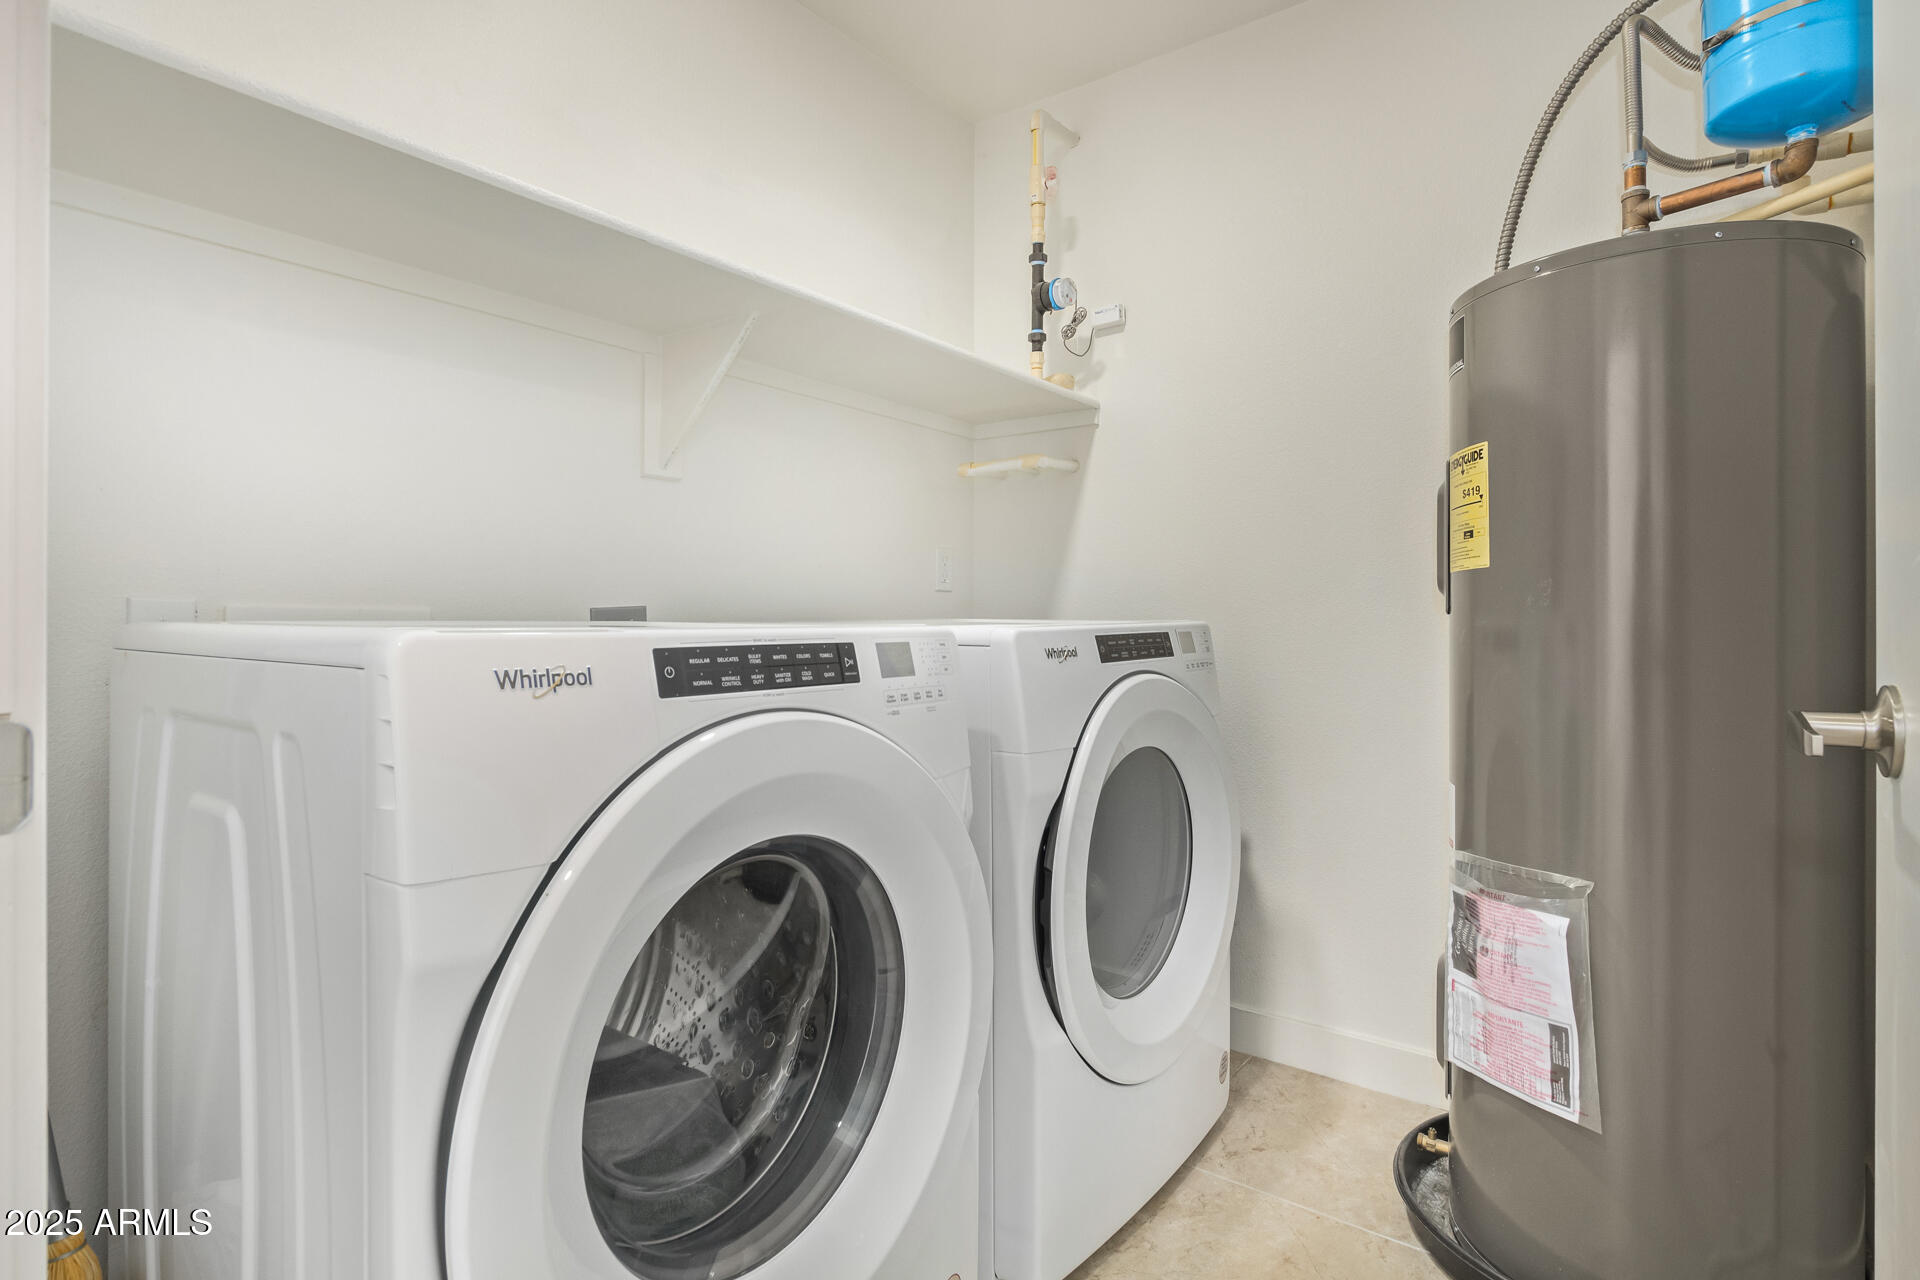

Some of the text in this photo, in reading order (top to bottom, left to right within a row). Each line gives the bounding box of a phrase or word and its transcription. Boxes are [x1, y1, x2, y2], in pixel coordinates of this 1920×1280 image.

[1462, 485, 1480, 499] $419
[1044, 646, 1078, 661] Whirlpool
[493, 667, 592, 693] Whirlpool
